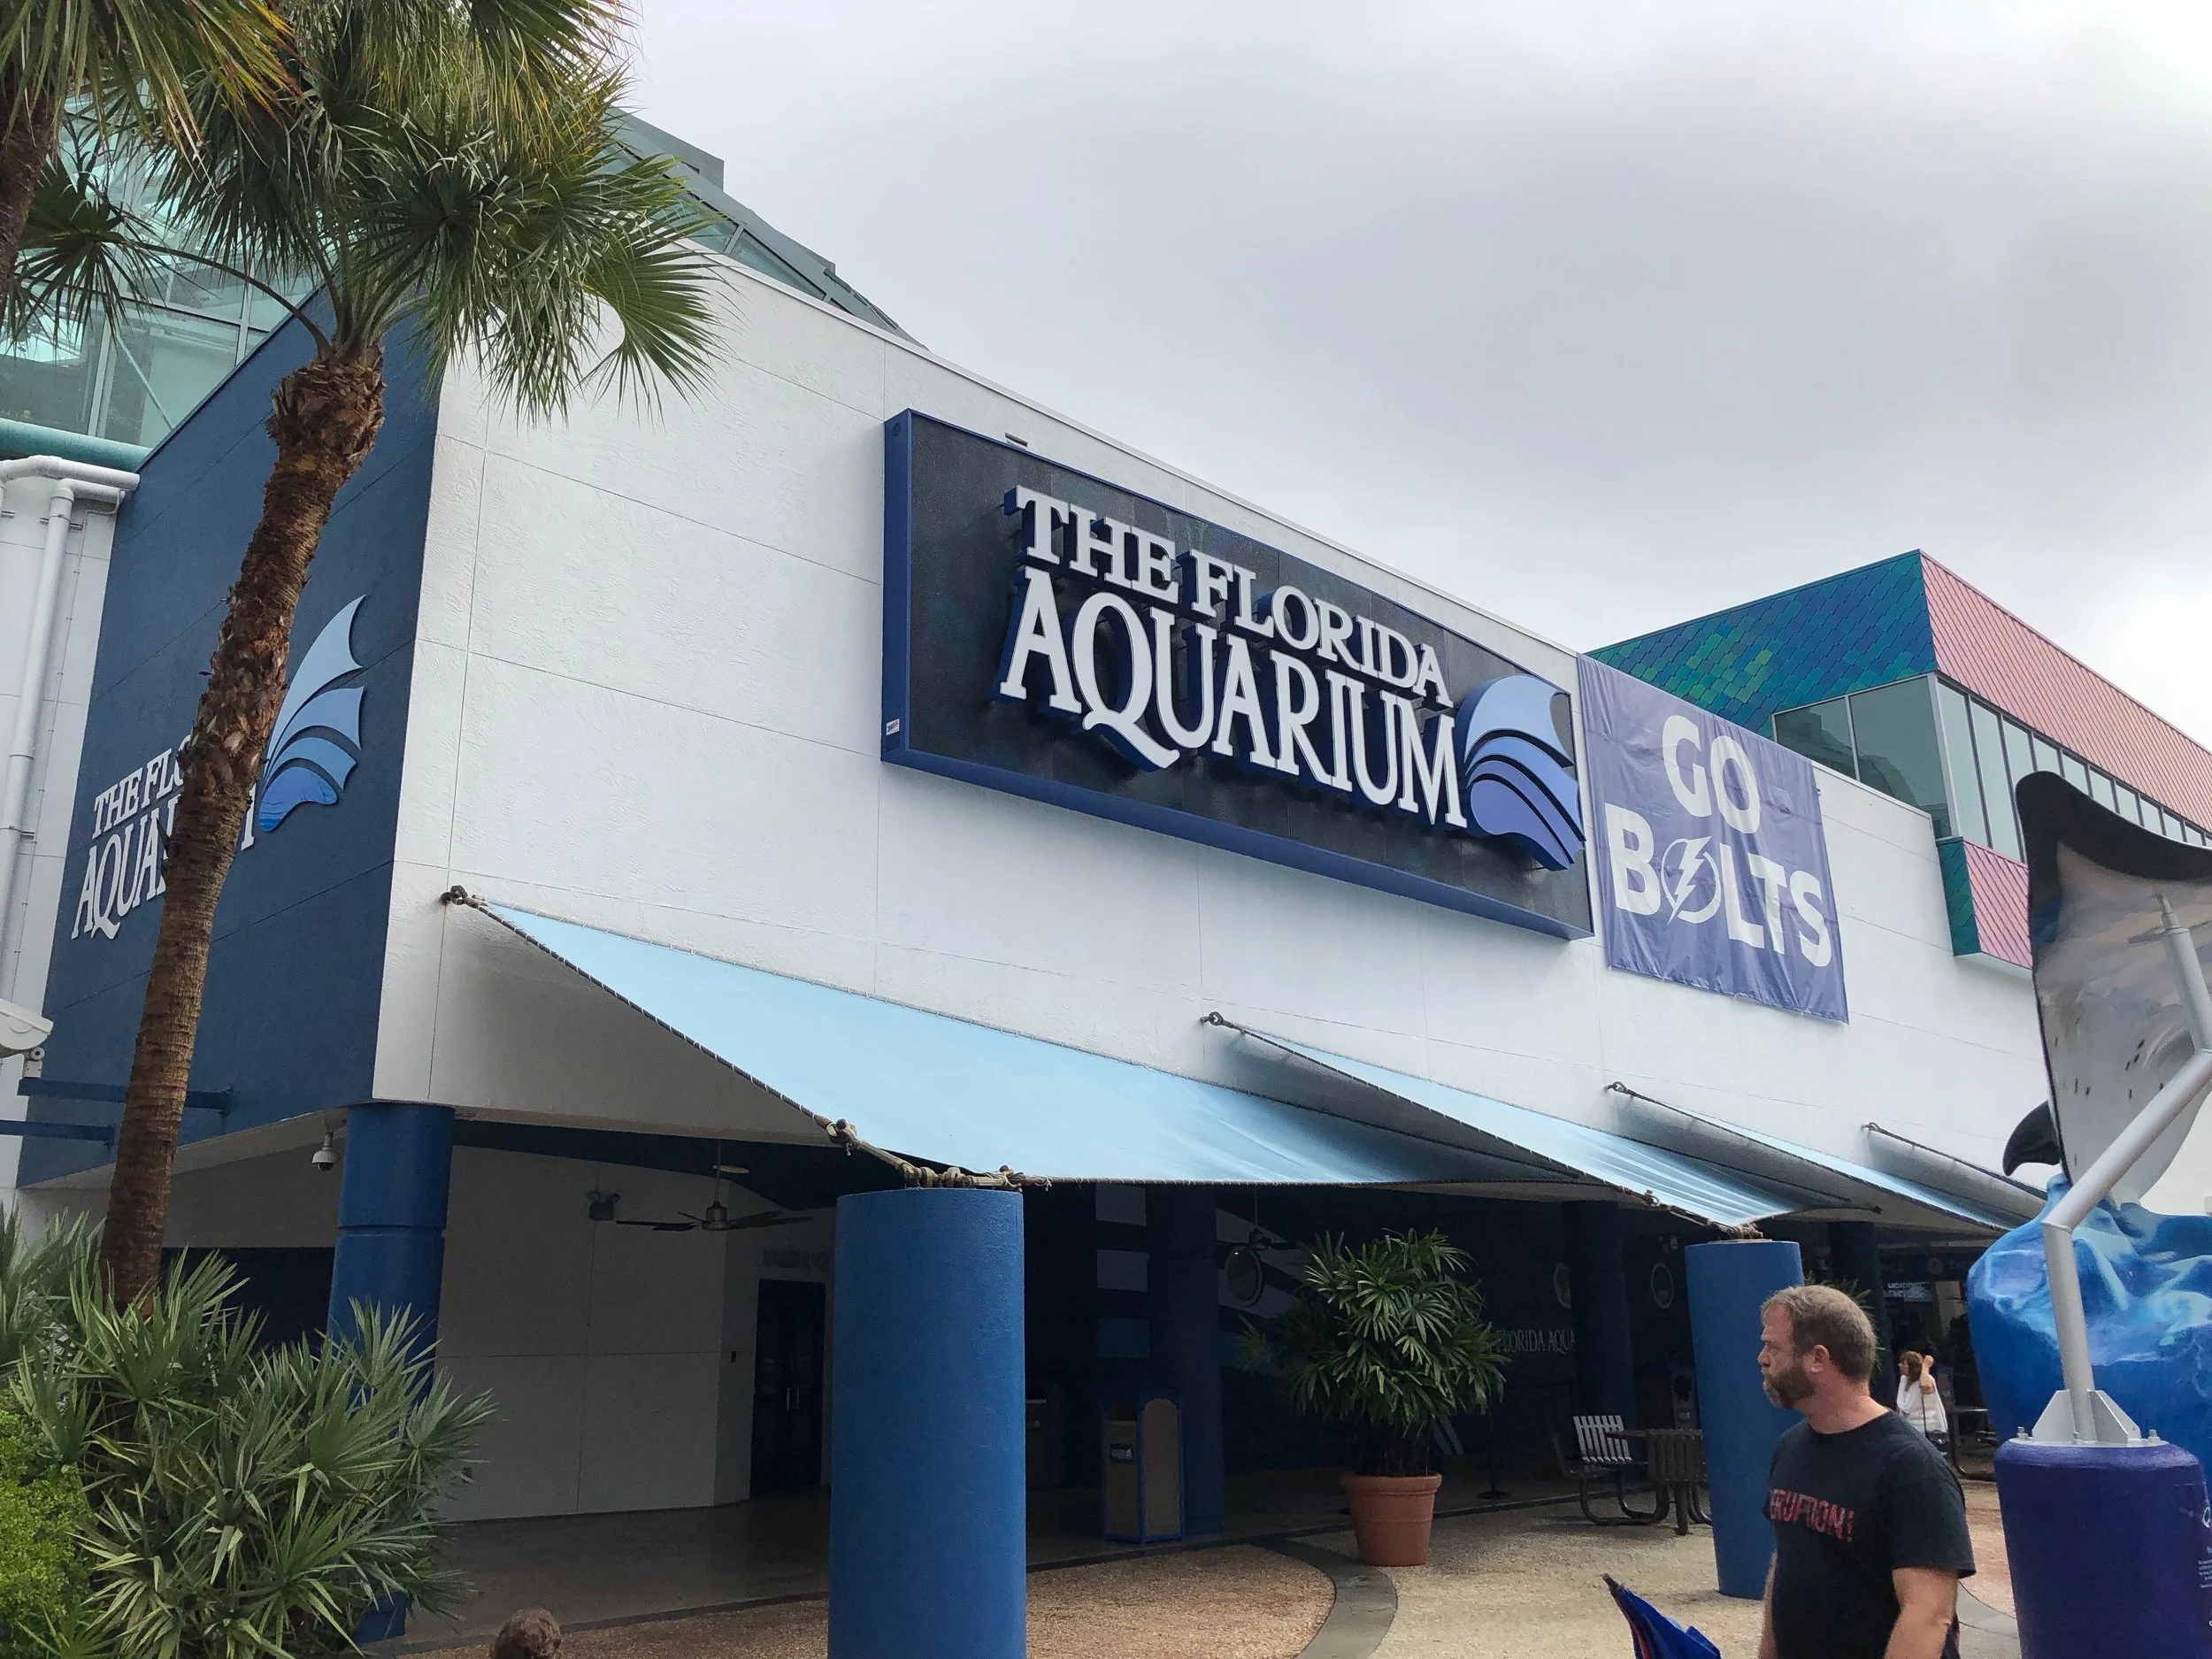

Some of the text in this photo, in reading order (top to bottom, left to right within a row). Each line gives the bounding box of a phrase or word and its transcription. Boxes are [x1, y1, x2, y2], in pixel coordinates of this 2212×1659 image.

[1016, 485, 1453, 707] THE FLORIDA
[999, 566, 1469, 828] AQUARIUM
[1662, 715, 1761, 834] GO
[92, 767, 143, 840] THE
